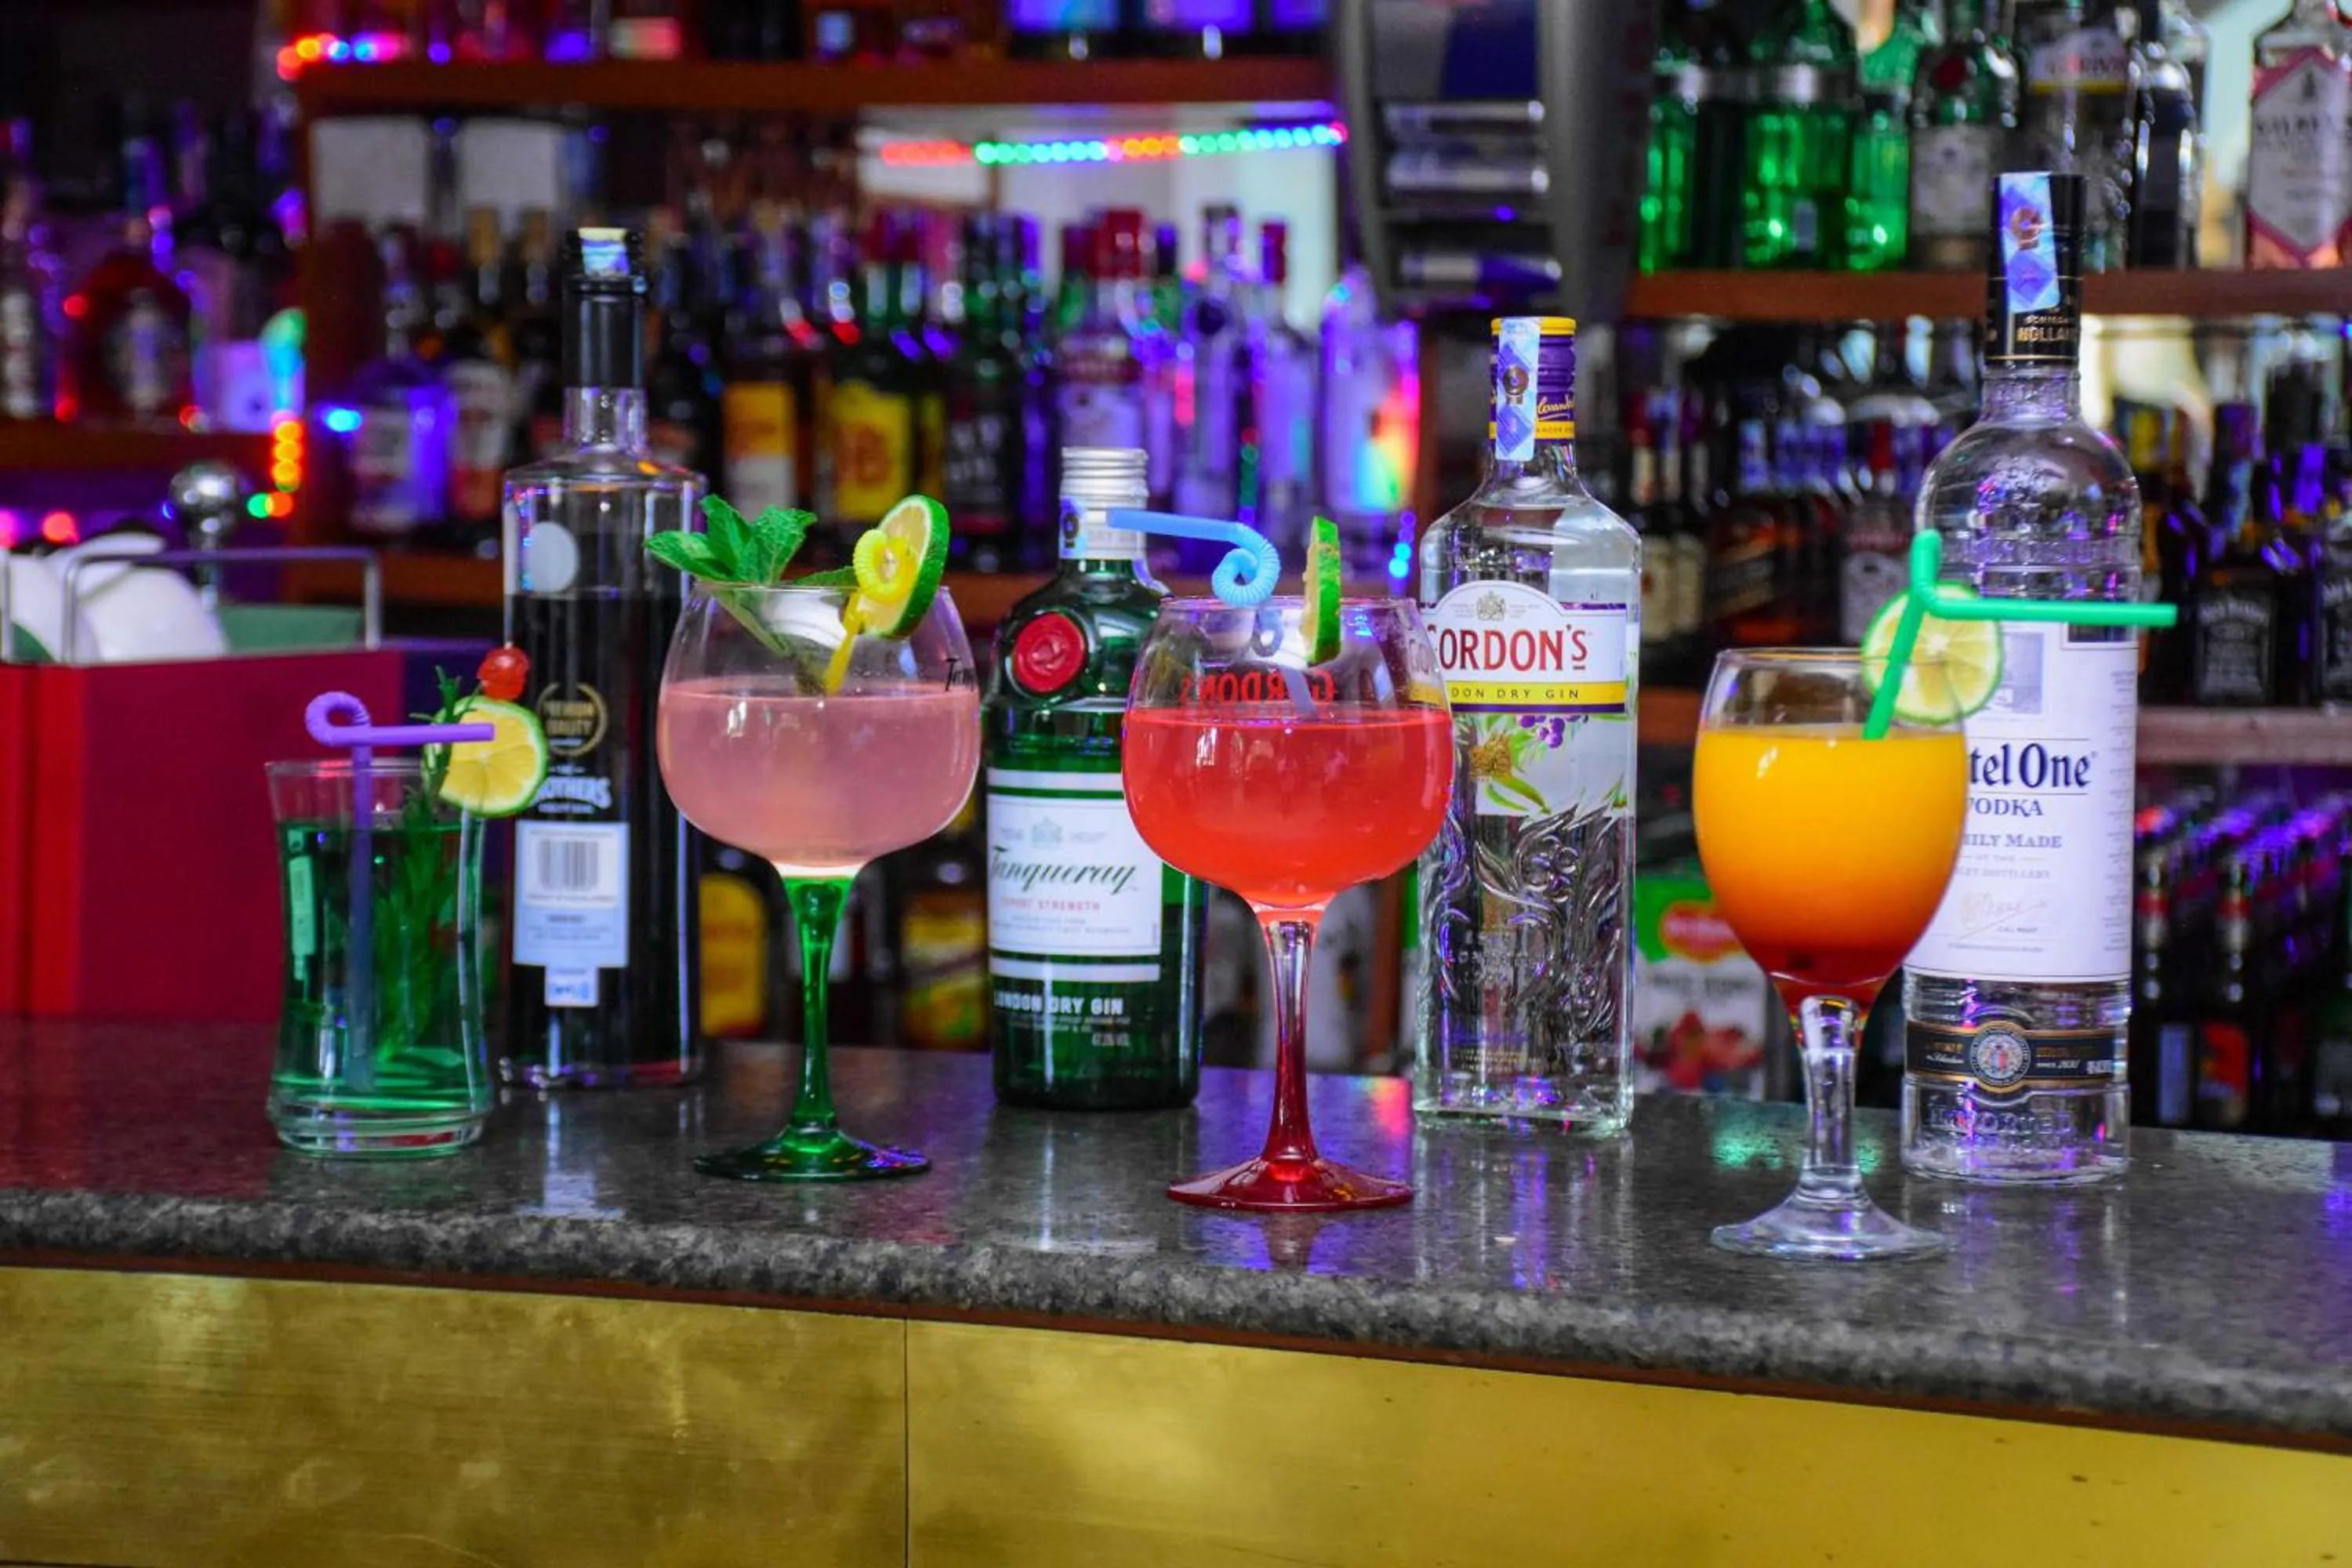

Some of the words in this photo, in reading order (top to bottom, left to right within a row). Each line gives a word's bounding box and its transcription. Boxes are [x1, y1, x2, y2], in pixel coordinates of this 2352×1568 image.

[2017, 326, 2070, 342] HOLLA
[1426, 624, 1587, 671] ORDON'S
[1451, 686, 1485, 699] DON
[1497, 686, 1531, 699] DRY
[1545, 687, 1579, 700] GIN
[1969, 744, 2011, 786] tel
[2019, 742, 2091, 789] One
[1964, 833, 2002, 847] ILY
[2003, 833, 2063, 849] MADE
[992, 845, 1136, 895] Tanqueray
[1051, 996, 1084, 1014] DRY
[1090, 996, 1124, 1015] GIN
